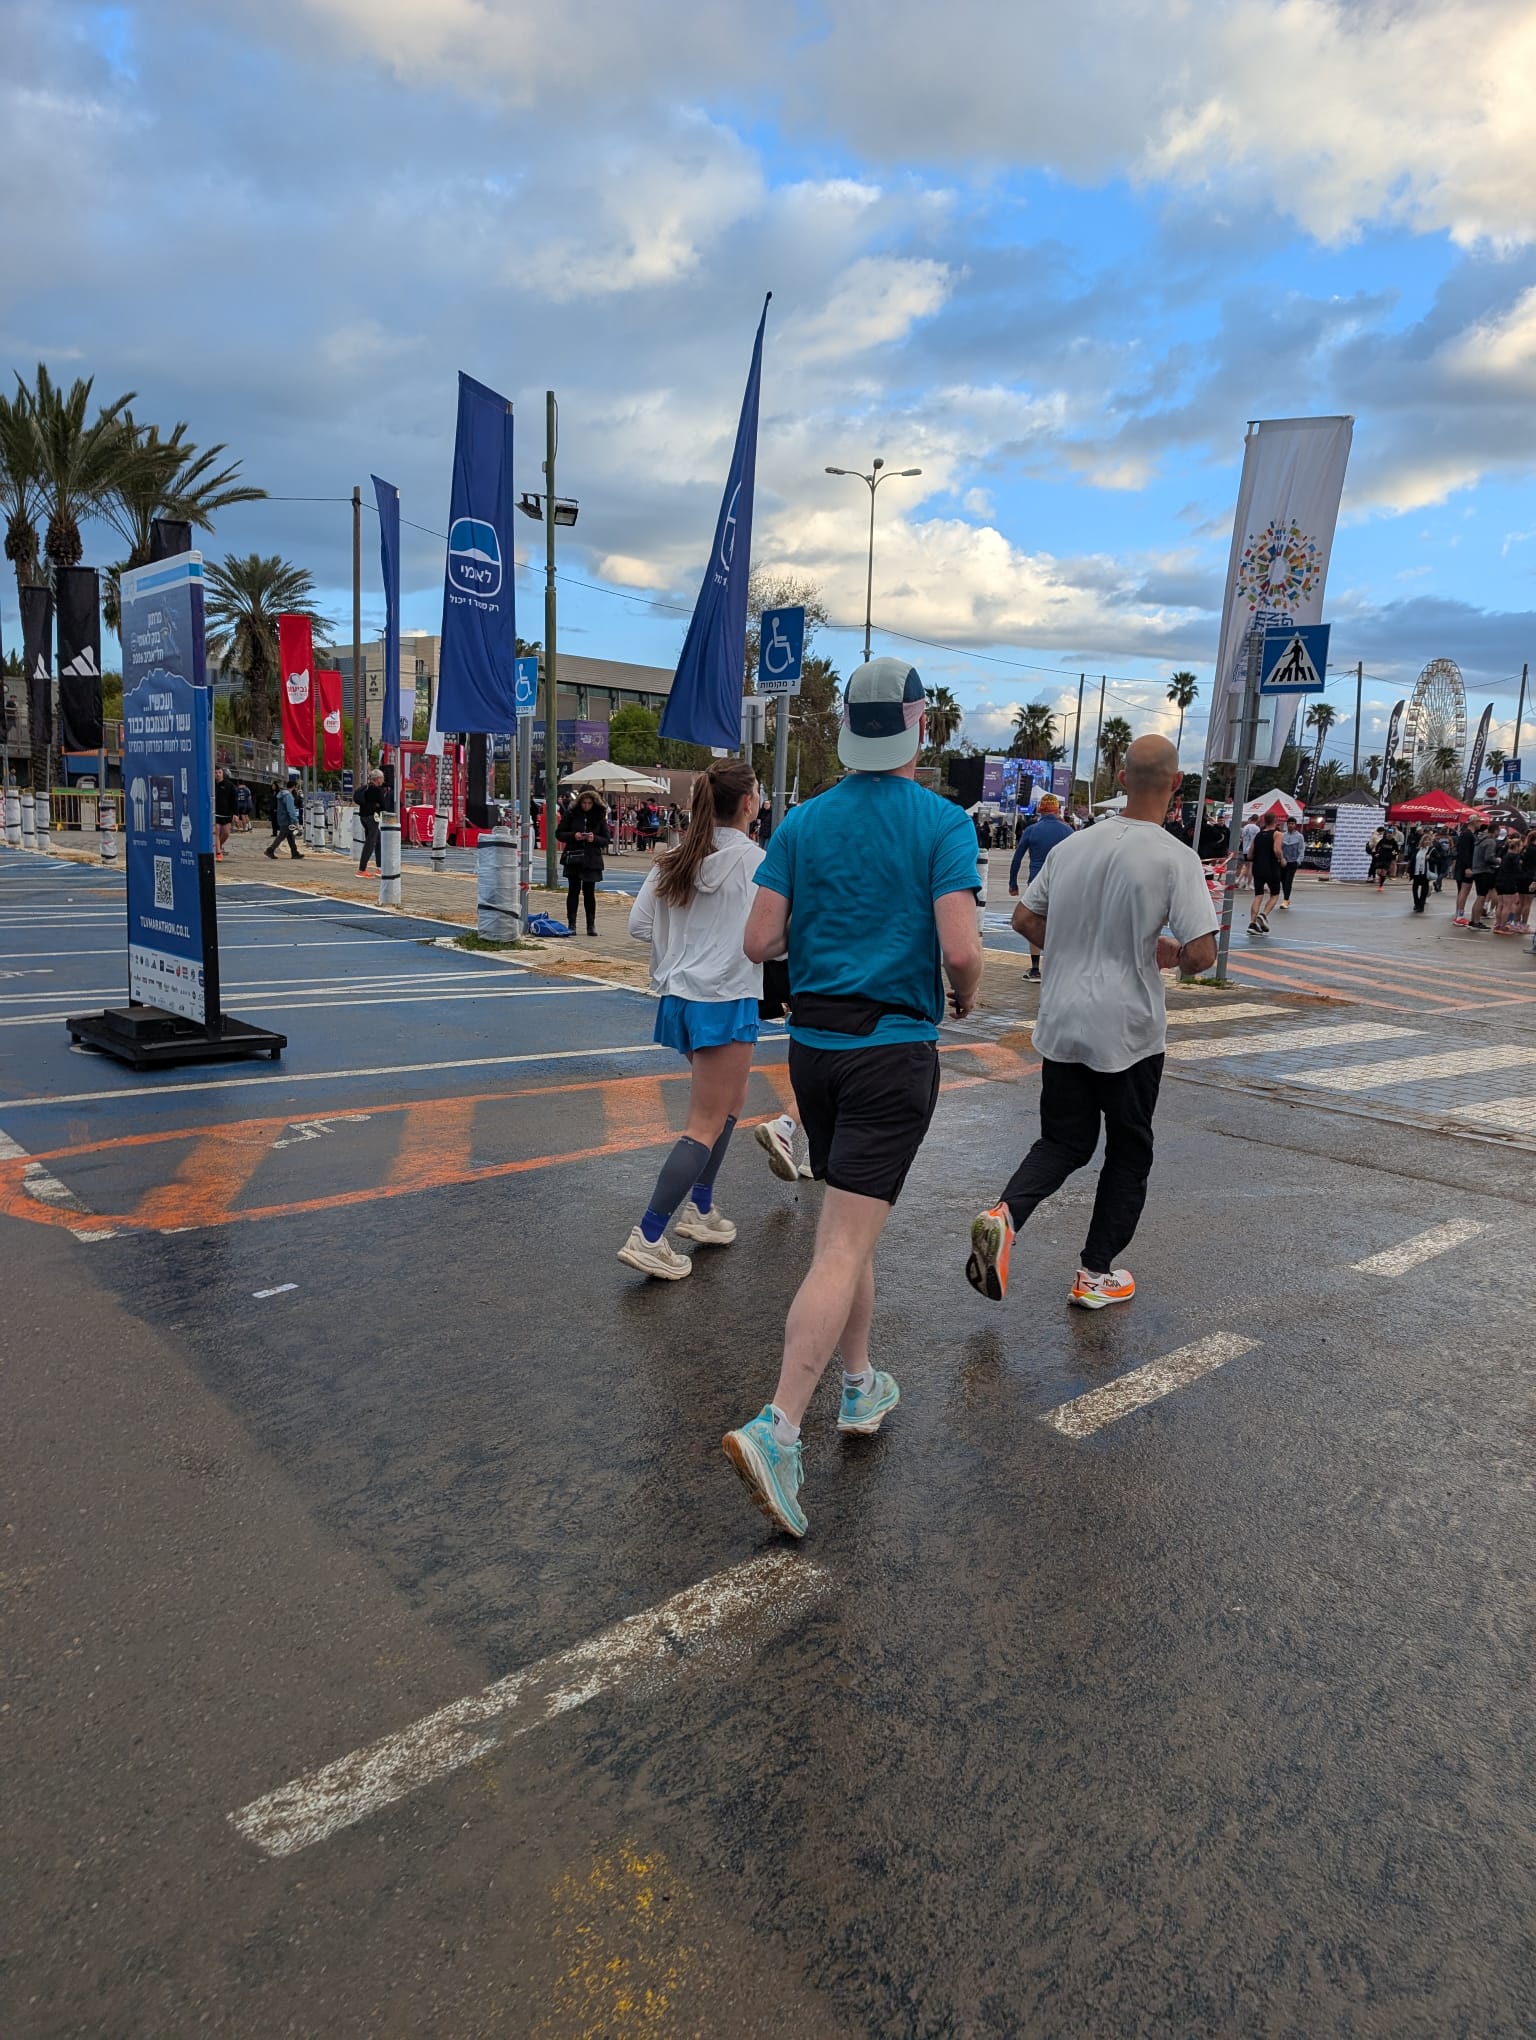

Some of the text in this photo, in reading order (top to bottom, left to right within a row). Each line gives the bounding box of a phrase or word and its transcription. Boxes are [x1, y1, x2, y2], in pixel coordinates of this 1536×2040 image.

[460, 564, 492, 584] לאומי
[760, 680, 788, 689] מקומות
[143, 692, 173, 712] ועכשיו...
[127, 710, 191, 734] עשו לעצמכם כבוד
[1467, 731, 1486, 789] saucony
[1400, 804, 1449, 813] saucony
[139, 914, 191, 939] TLVMARATHON.CO.IL
[1103, 1277, 1122, 1289] HOKA
